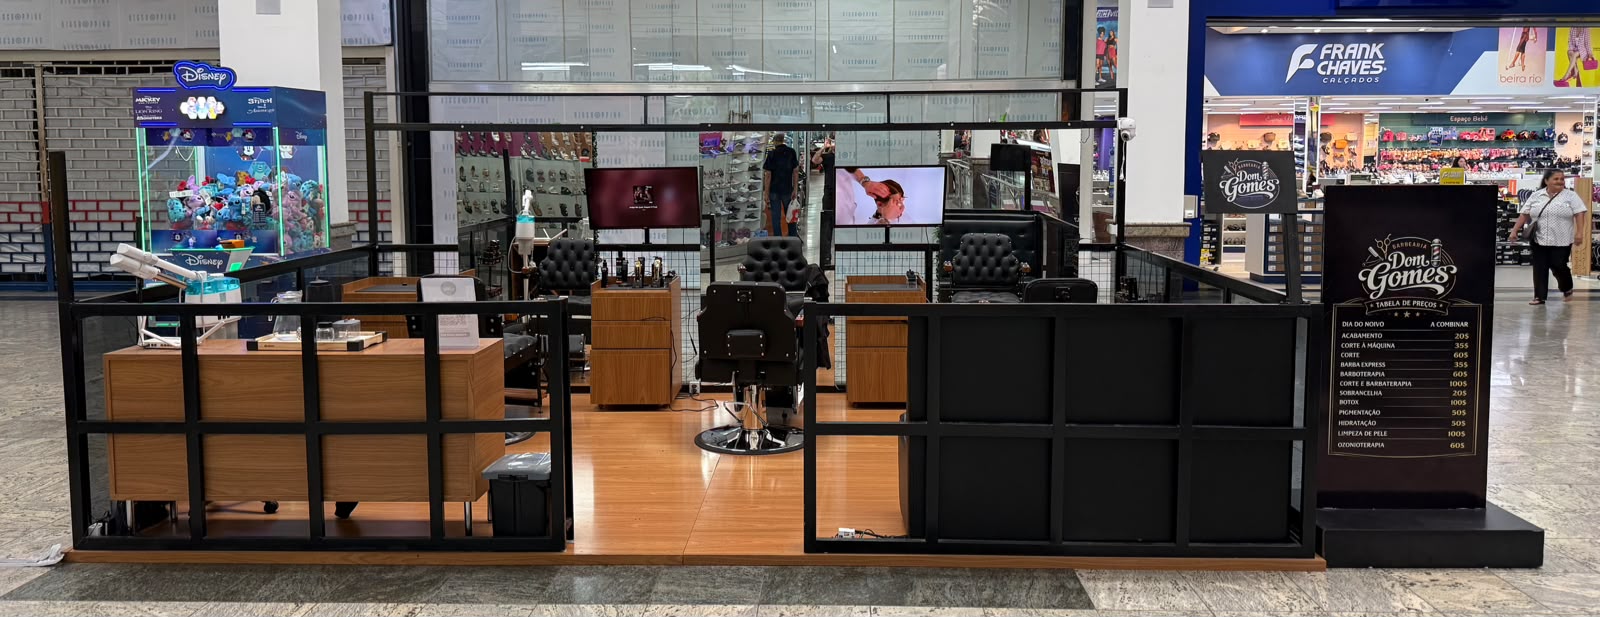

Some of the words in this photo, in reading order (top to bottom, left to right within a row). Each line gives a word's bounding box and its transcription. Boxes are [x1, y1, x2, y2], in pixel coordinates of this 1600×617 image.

[1320, 43, 1384, 60] FRANK
[1317, 60, 1386, 75] CHAVES
[178, 66, 226, 86] Disney
[1500, 74, 1526, 83] beira
[1529, 74, 1542, 83] rio
[1237, 170, 1262, 182] Dom
[1220, 177, 1280, 202] Gomes
[182, 254, 224, 269] Disney
[1388, 251, 1430, 269] Dom
[1358, 262, 1457, 300] Gomes
[1376, 300, 1400, 308] TABELA
